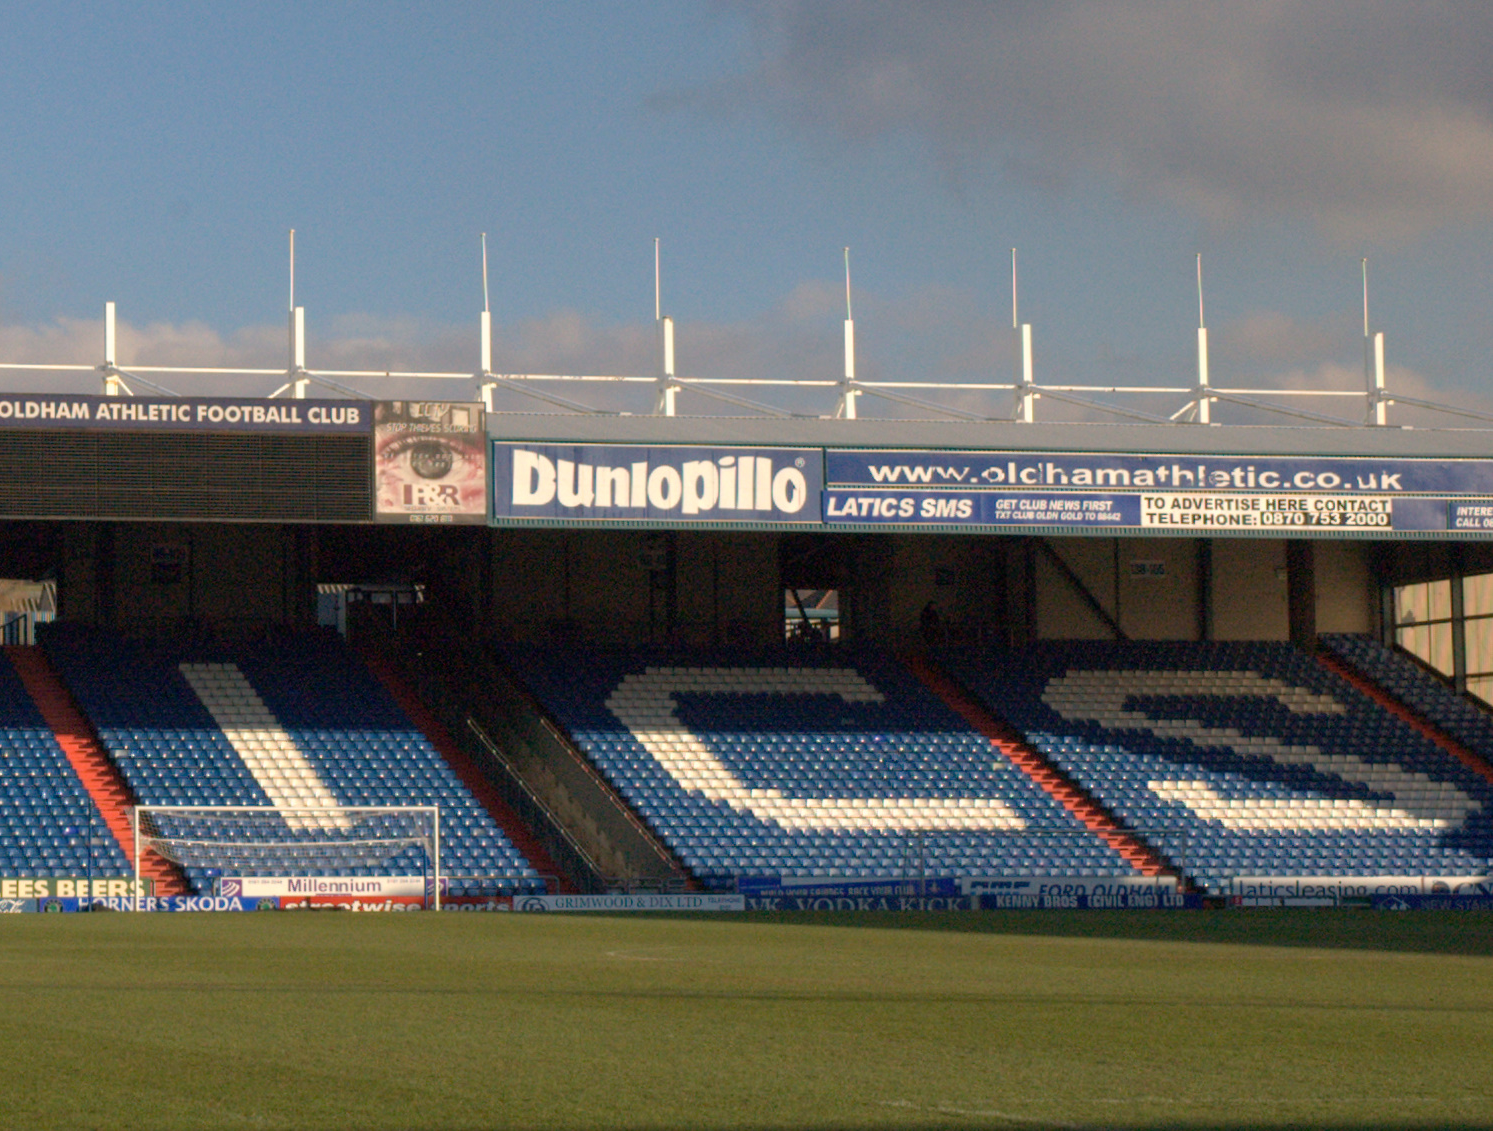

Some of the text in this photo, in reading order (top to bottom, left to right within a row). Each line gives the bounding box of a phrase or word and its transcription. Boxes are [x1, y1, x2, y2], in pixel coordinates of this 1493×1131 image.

[95, 402, 191, 422] ATHLETIC
[196, 405, 303, 423] FOOTBALL
[307, 407, 359, 424] CLUB
[827, 497, 973, 518] LATICS SMS
[995, 499, 1113, 511] GET CLUB NEWS FIRST
[1144, 497, 1389, 512] TO ADVERTISE HERE CONTACT
[995, 511, 1012, 519] TXT
[1060, 512, 1083, 520] GOLD
[1084, 512, 1096, 520] TO
[1146, 512, 1388, 526] TELEPHONE: 0870 753 2000
[1456, 517, 1481, 528] CALL
[57, 879, 145, 898] BEERS
[287, 878, 381, 893] Millennium
[1239, 880, 1418, 897] laticsleasingcom
[175, 896, 243, 912] SKODA
[555, 895, 703, 909] GRIMWOOD & DIX LTD
[797, 898, 890, 910] VODKA
[899, 897, 964, 911] KICK
[996, 895, 1040, 907] KENNY
[1043, 895, 1079, 907] BROS
[1163, 895, 1185, 907] LTD
